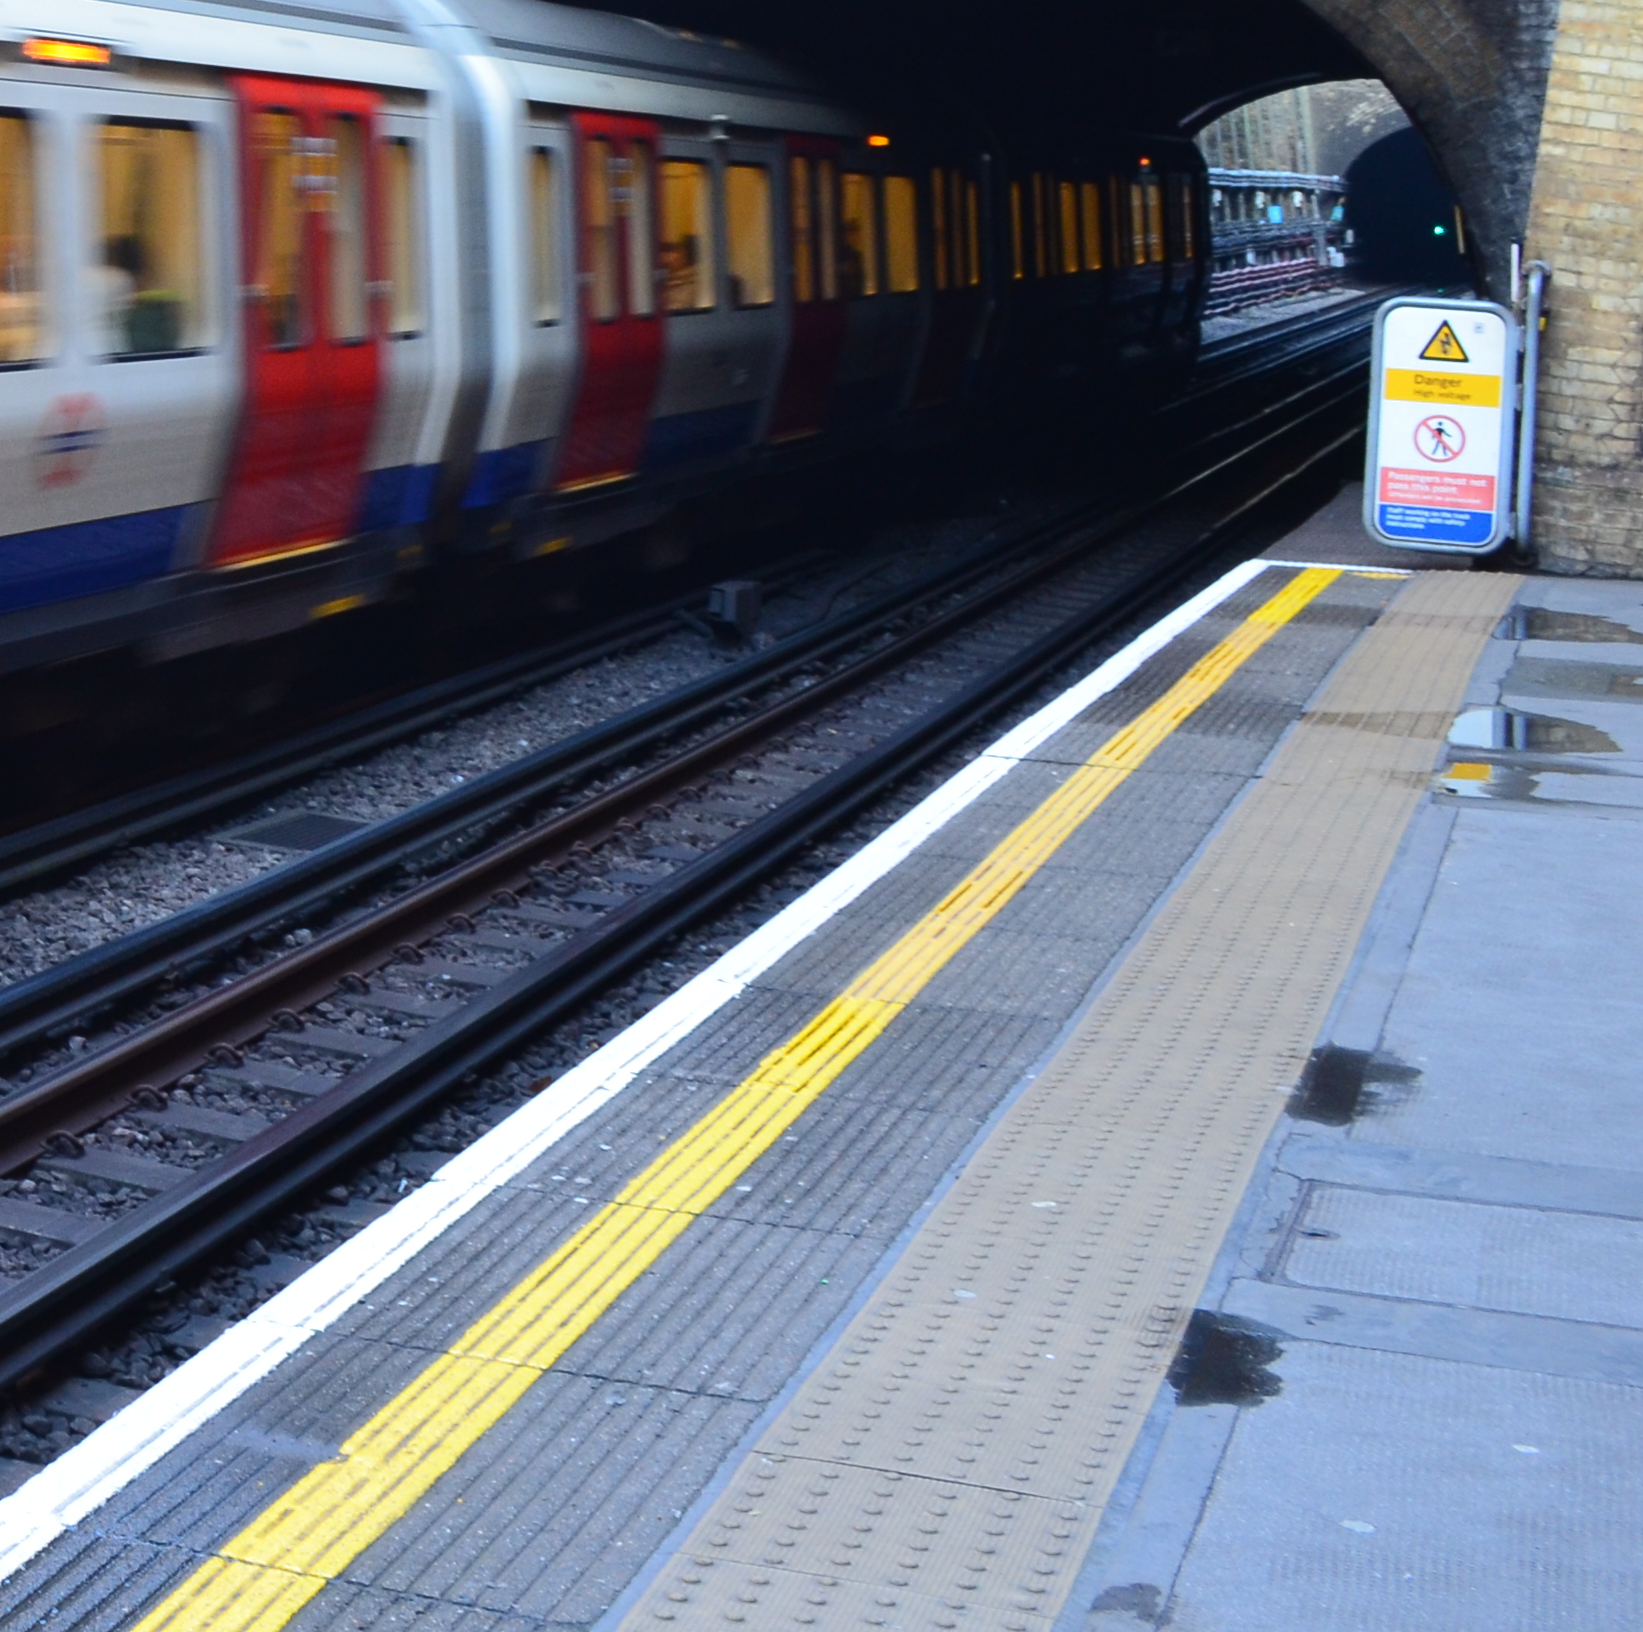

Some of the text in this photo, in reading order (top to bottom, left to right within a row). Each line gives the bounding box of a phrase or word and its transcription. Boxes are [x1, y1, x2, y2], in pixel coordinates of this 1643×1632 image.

[1415, 374, 1462, 389] Danger
[1388, 471, 1488, 487] Passengers must not
[1387, 482, 1458, 495] pass this point
